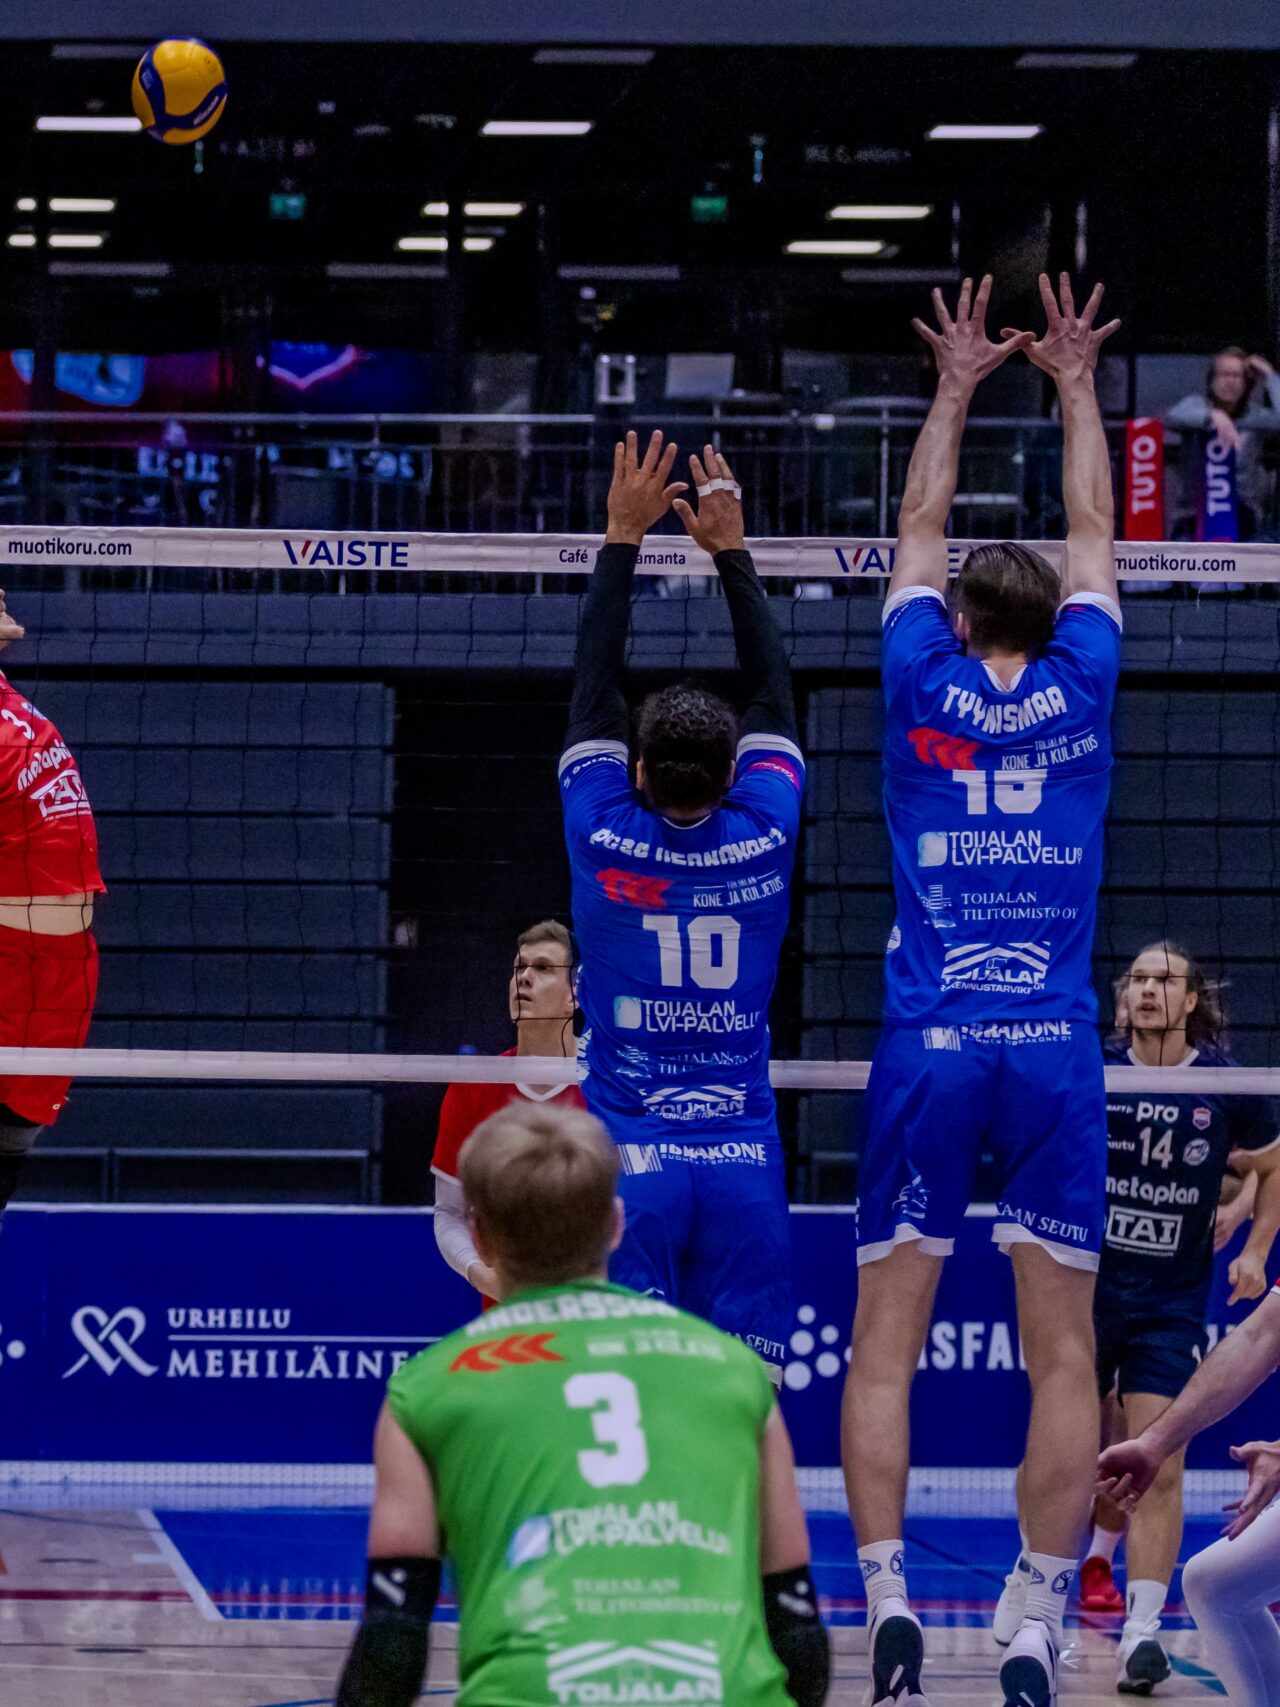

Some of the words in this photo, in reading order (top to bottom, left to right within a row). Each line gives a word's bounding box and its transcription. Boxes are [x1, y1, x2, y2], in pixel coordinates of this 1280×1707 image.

[1132, 435, 1157, 515] TUTO
[8, 537, 132, 556] muotikoru.com
[283, 540, 409, 567] VAISTE
[559, 548, 589, 564] Café
[835, 547, 960, 573] VAIE
[1115, 553, 1236, 572] muotikoru.com
[1001, 754, 1031, 771] KONE
[1034, 752, 1048, 768] JA
[1051, 734, 1099, 766] KULJETUS
[949, 830, 1042, 849] TOIJALAN
[952, 846, 1076, 865] LVI-PALVELU
[693, 893, 724, 907] KONE
[727, 891, 740, 905] JA
[961, 891, 1038, 905] TOIJALAN
[961, 907, 1060, 920] TILITOIMISTO
[1061, 907, 1079, 920] OY
[642, 915, 741, 990] 10
[642, 1000, 736, 1017] TOIJALAN
[1107, 1134, 1135, 1151] uutu
[1139, 1126, 1173, 1169] 14
[1105, 1176, 1199, 1206] netaplan
[1038, 1217, 1088, 1242] SEUTU
[167, 1308, 292, 1329] URHEILU
[166, 1345, 410, 1380] MEHILÄINE
[563, 1371, 649, 1489] 3
